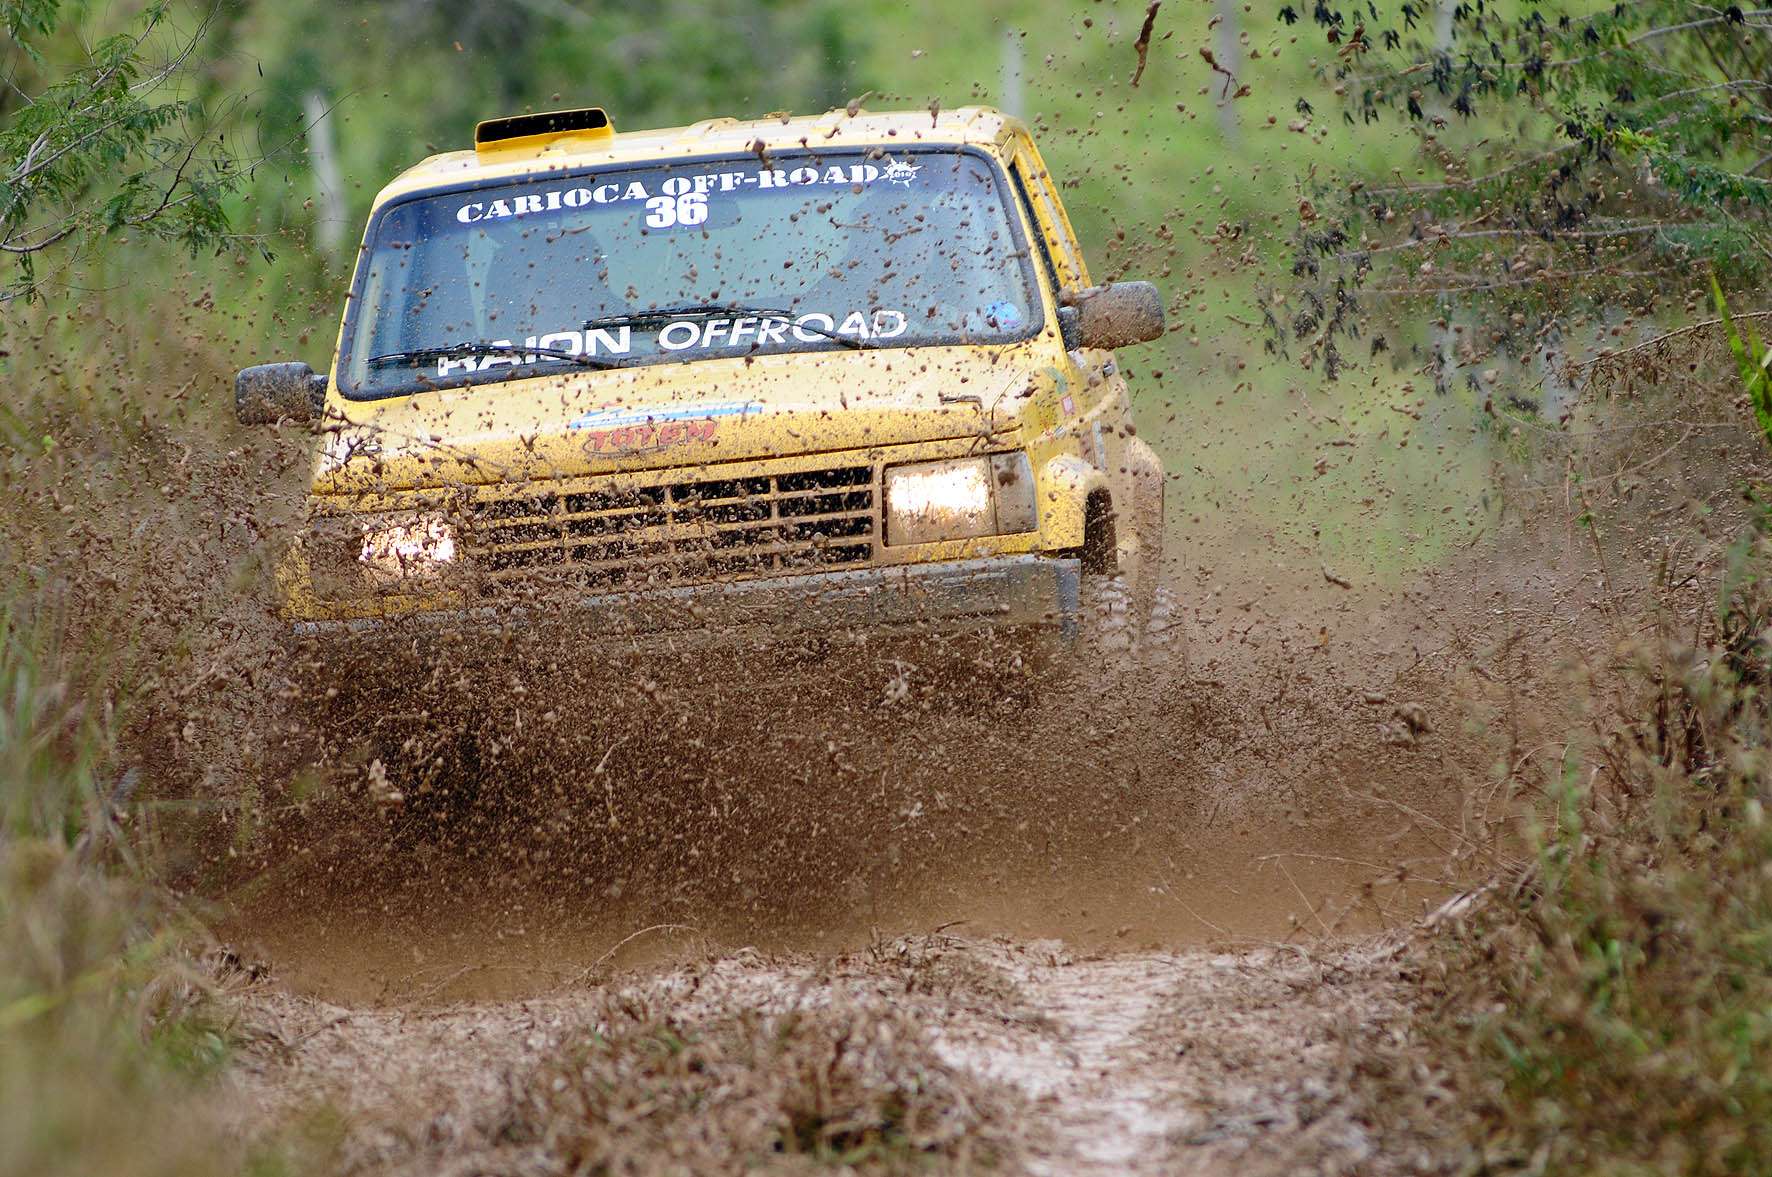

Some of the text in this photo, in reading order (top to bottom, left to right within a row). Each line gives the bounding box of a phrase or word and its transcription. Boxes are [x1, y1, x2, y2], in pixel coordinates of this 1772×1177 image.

[456, 180, 650, 224] CARIOCA
[661, 163, 881, 196] OFF-ROAD
[645, 192, 709, 229] 36
[657, 310, 908, 351] OFFROAD
